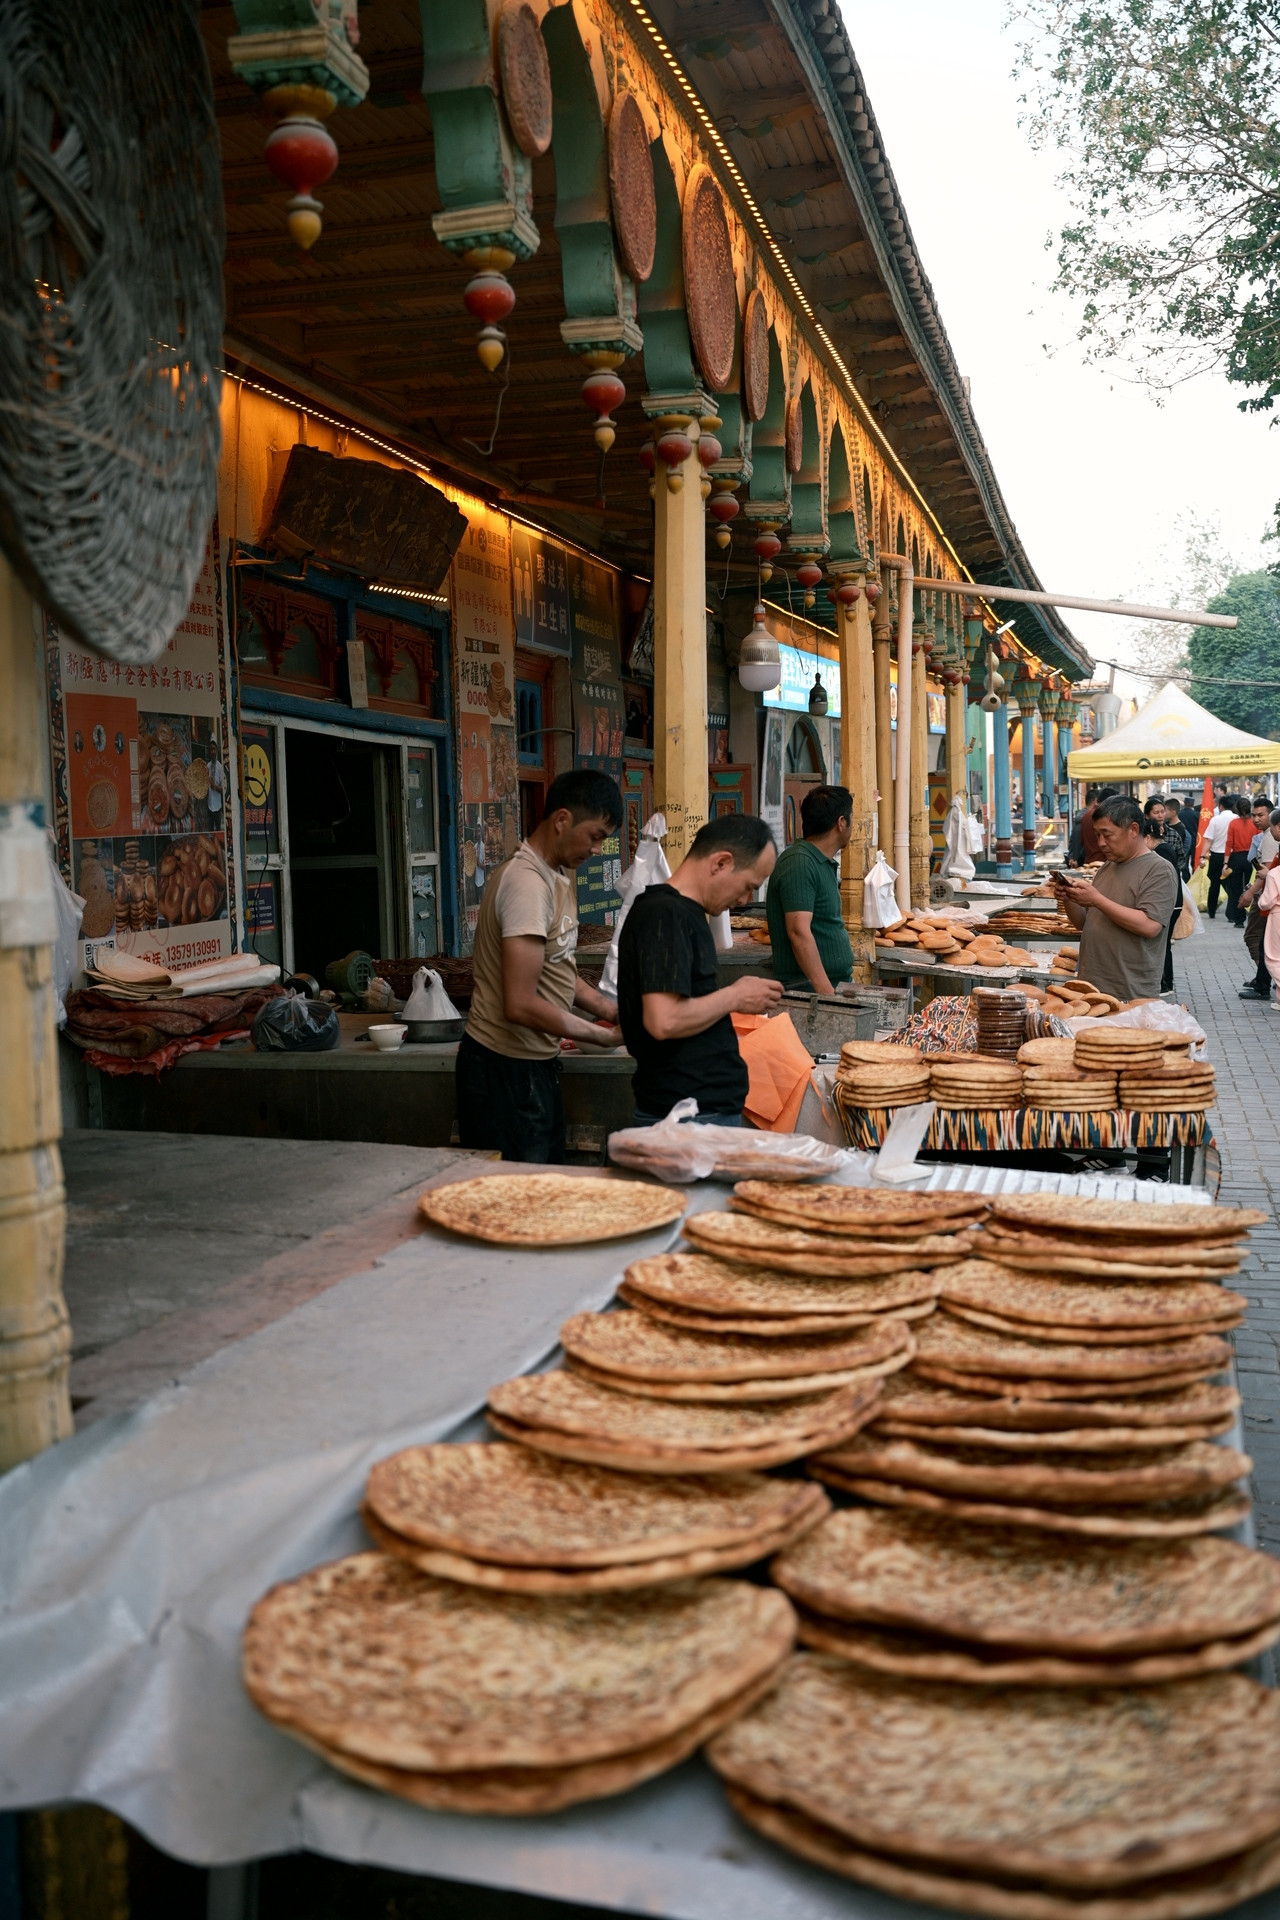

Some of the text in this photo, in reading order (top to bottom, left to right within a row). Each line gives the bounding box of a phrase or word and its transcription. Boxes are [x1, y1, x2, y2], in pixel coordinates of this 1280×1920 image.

[536, 553, 565, 592] 聚过来
[176, 620, 214, 637] 将及时取走打
[538, 600, 567, 635] 卫生间
[166, 938, 221, 962] 13579130991
